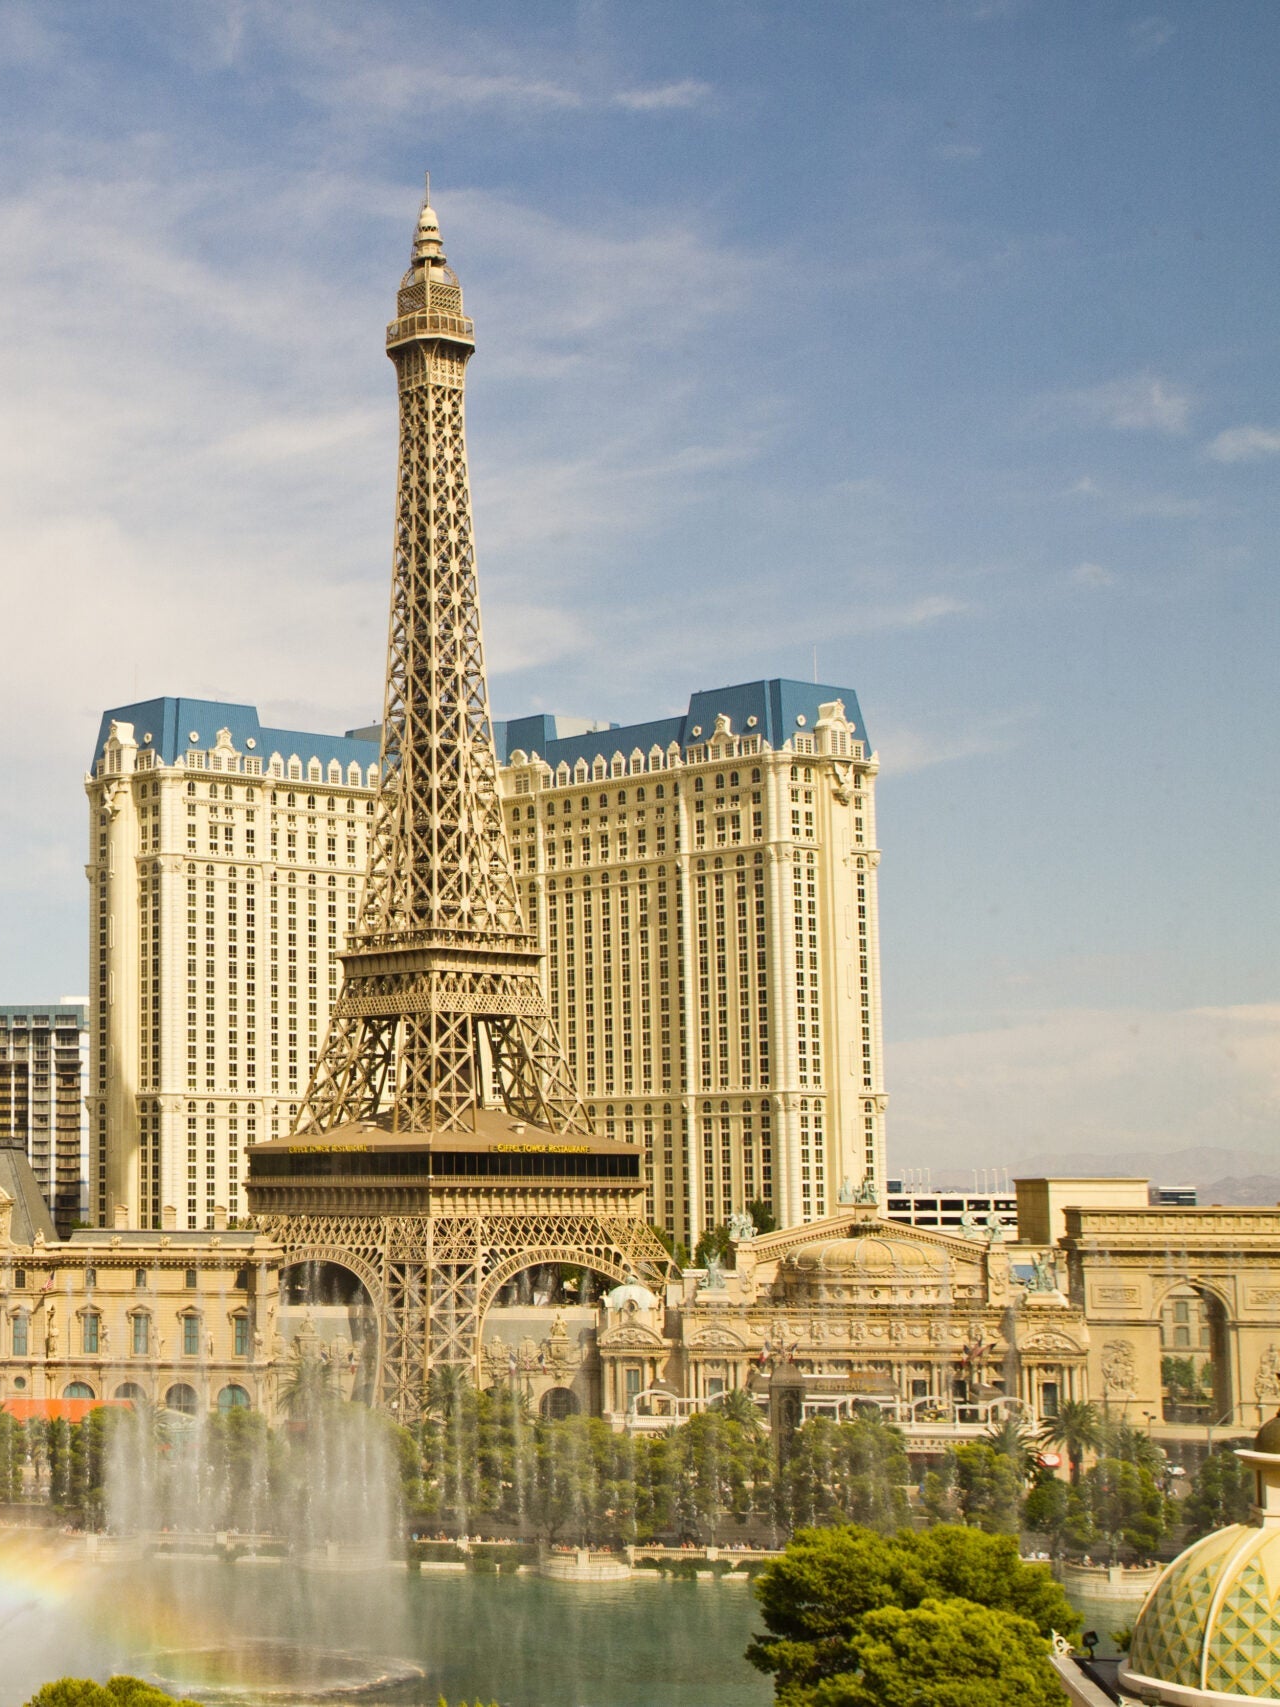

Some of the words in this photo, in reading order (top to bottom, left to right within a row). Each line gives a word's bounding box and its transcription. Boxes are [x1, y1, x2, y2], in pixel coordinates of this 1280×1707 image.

[497, 1143, 520, 1153] EIFFEL
[521, 1143, 545, 1153] TOWER
[548, 1143, 589, 1153] RESTAURANT
